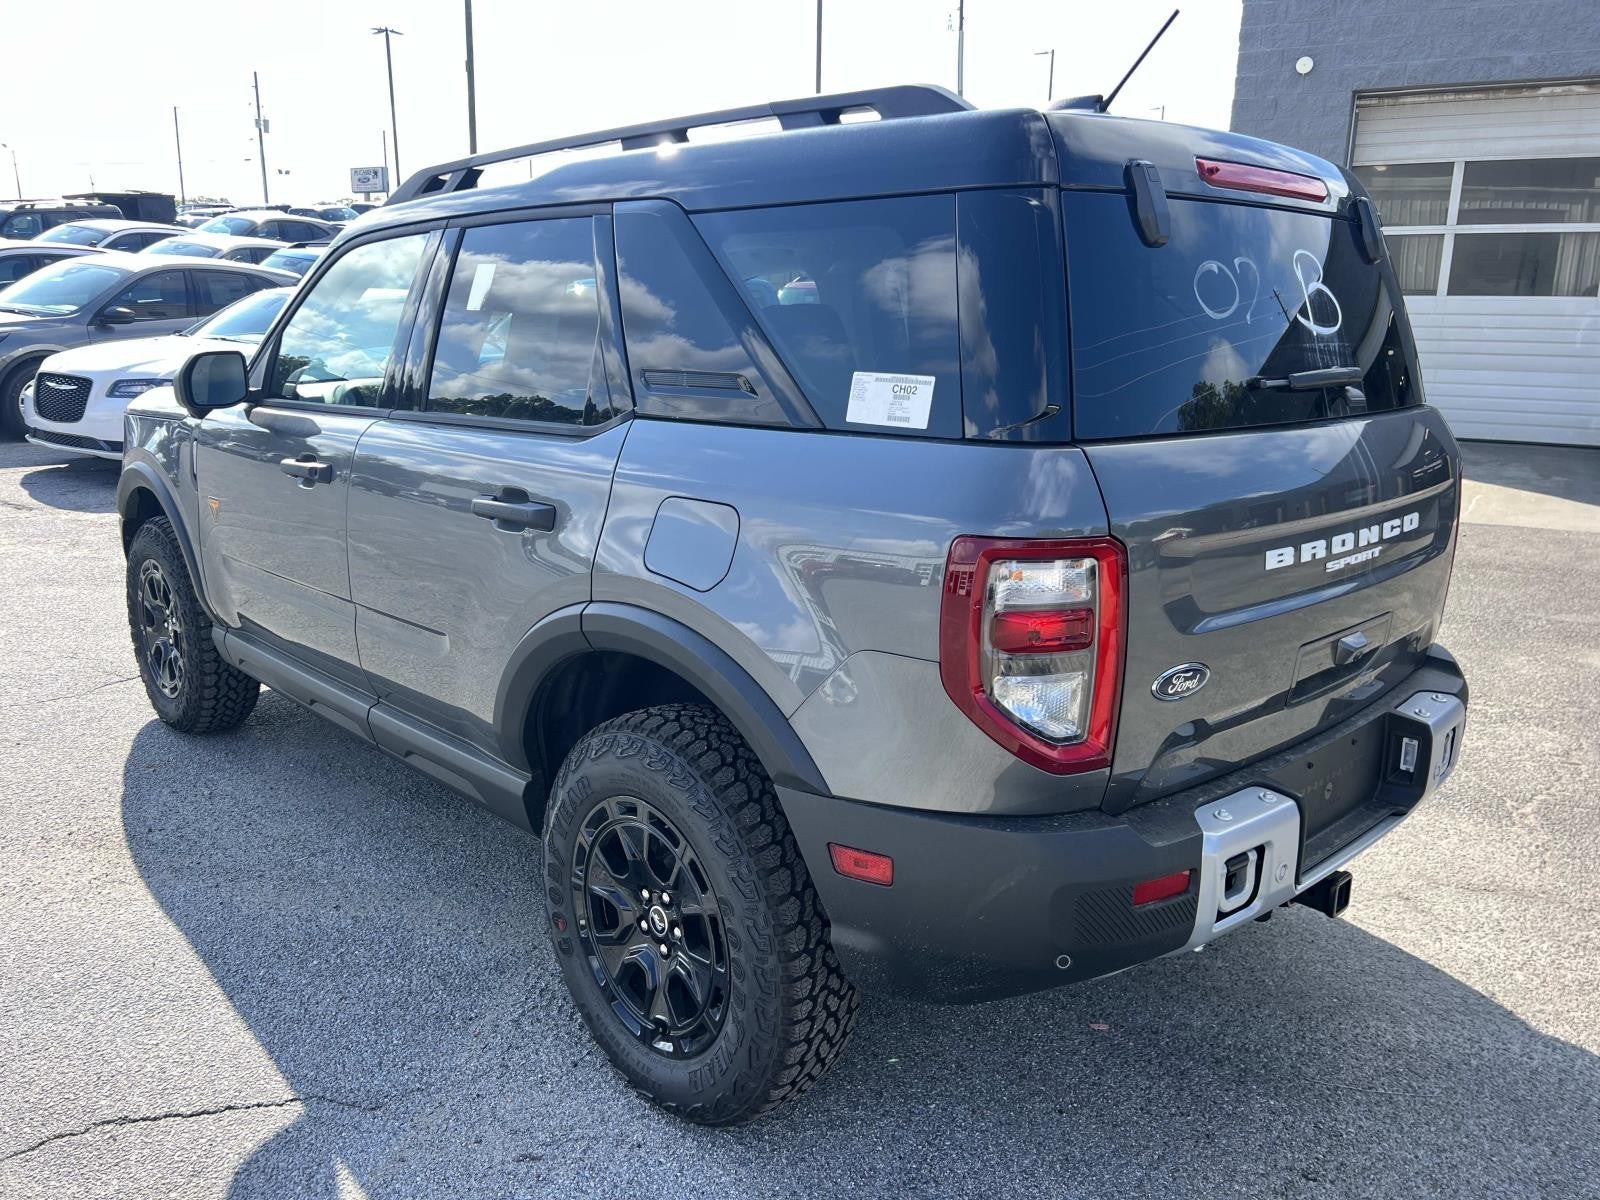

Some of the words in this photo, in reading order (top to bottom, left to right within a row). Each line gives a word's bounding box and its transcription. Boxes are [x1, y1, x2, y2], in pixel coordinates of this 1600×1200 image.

[892, 384, 918, 395] CH02
[1265, 511, 1420, 570] BRONCO
[1325, 546, 1383, 573] SPORT
[1168, 671, 1200, 694] Ford
